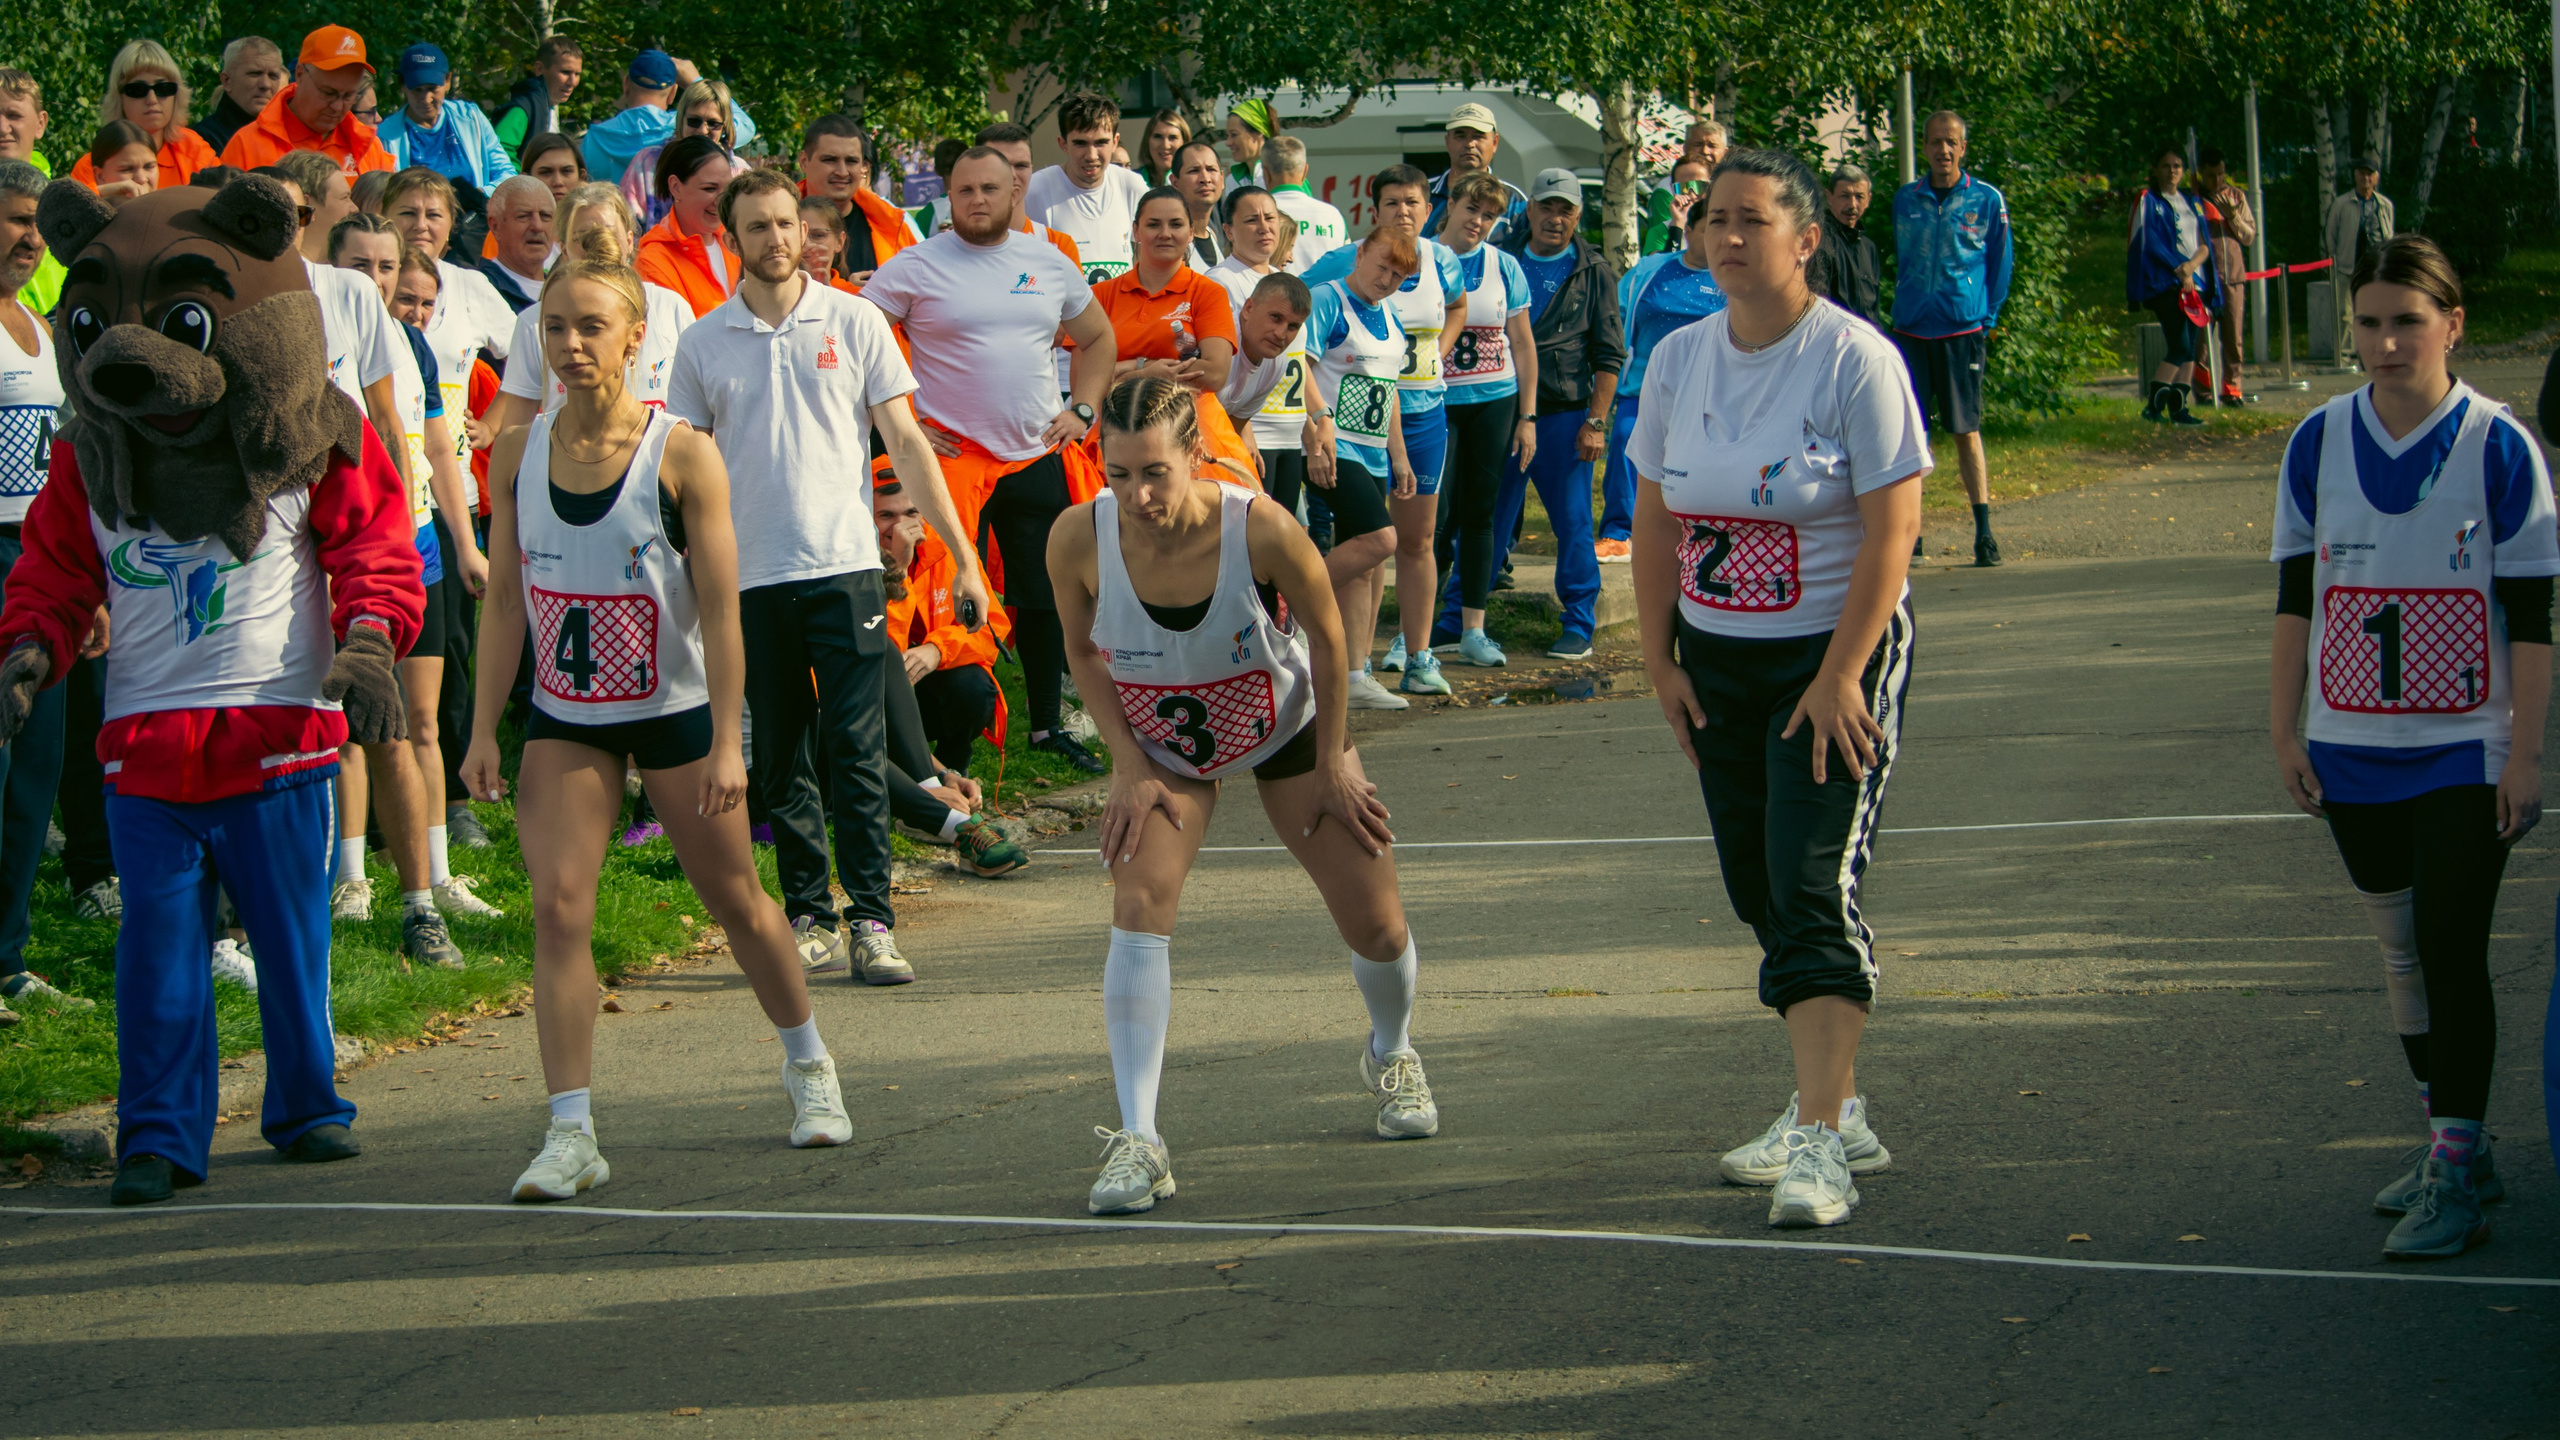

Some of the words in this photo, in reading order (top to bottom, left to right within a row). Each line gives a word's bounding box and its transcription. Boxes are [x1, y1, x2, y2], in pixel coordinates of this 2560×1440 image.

[817, 352, 829, 362] 80
[1453, 331, 1479, 371] 8
[1285, 358, 1303, 407] 2
[1364, 384, 1387, 431] 8
[457, 434, 465, 457] 2
[1688, 525, 1733, 599] 2
[1774, 577, 1786, 602] 1
[556, 607, 598, 692] 4
[1115, 649, 1164, 658] КРАСНОЯРСКИЙ
[2363, 603, 2401, 701] 1
[633, 659, 647, 691] 1
[2459, 666, 2475, 703] 1
[1156, 695, 1216, 767] 3
[1251, 716, 1265, 739] 1
